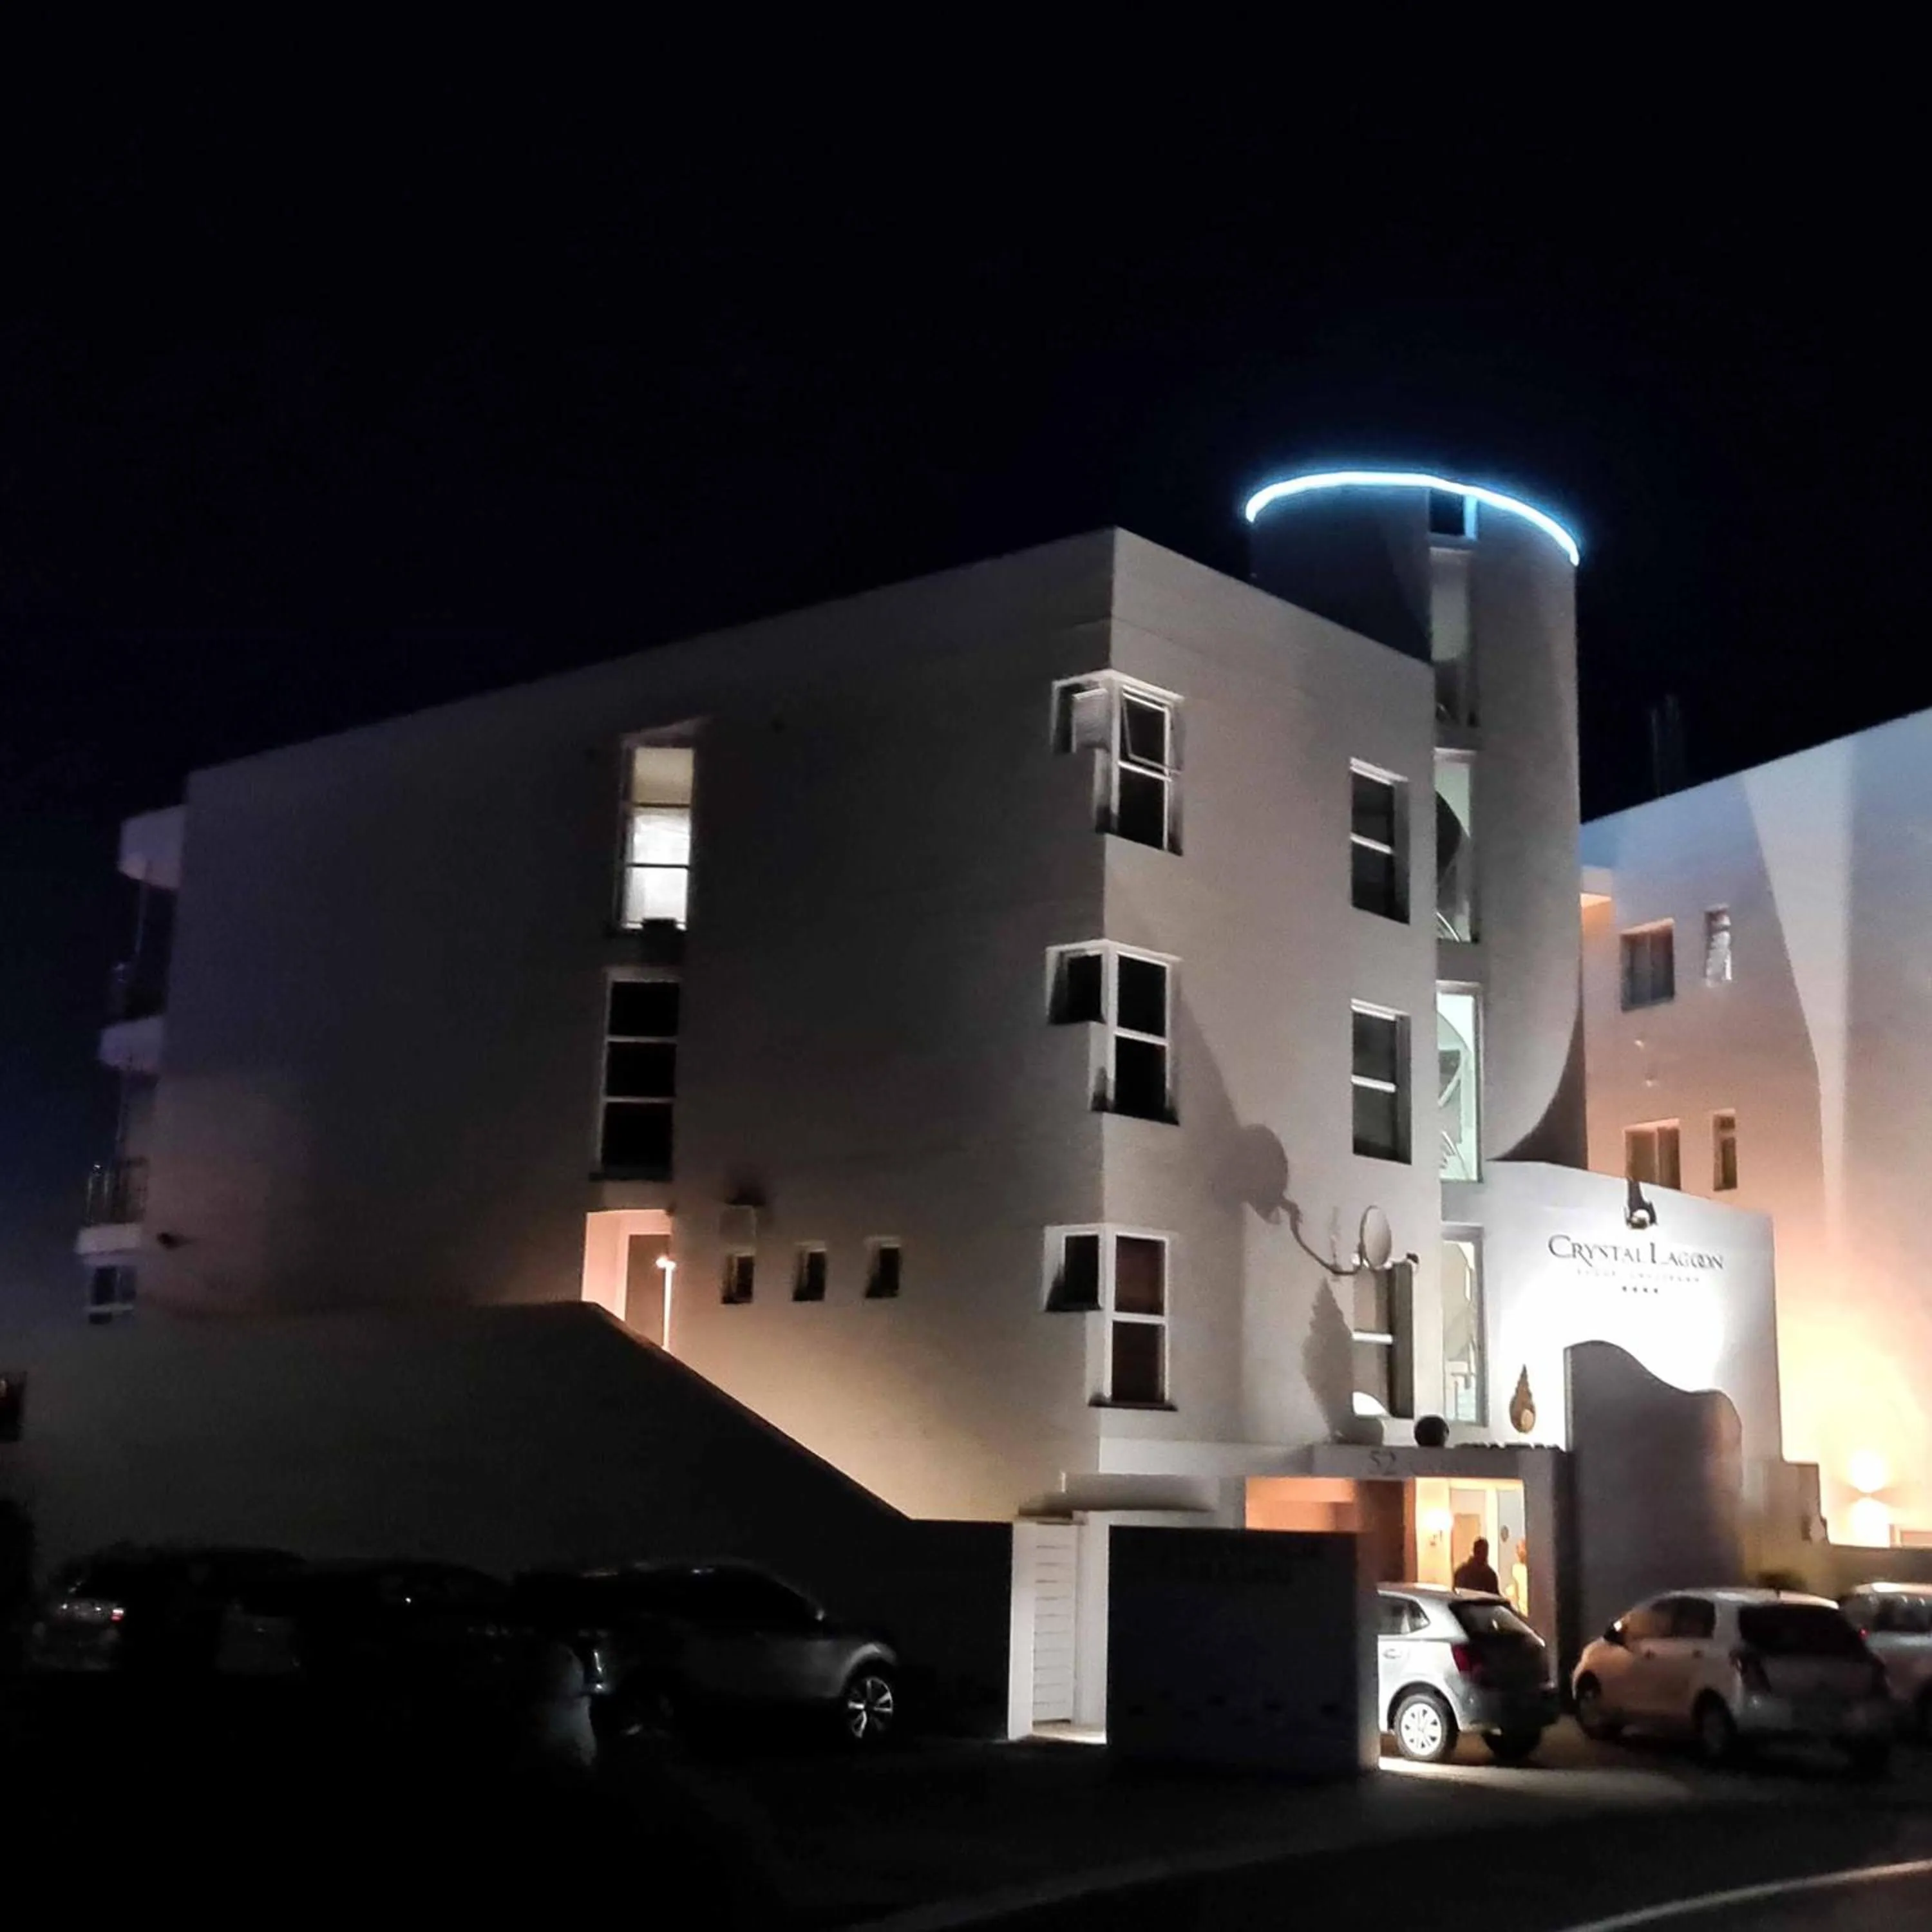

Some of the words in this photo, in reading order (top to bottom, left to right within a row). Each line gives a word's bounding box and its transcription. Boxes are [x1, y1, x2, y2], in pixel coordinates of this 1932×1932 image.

[1548, 1234, 1646, 1267] CRYSTAL
[1650, 1241, 1724, 1269] LAGOON
[1368, 1450, 1397, 1475] 52
